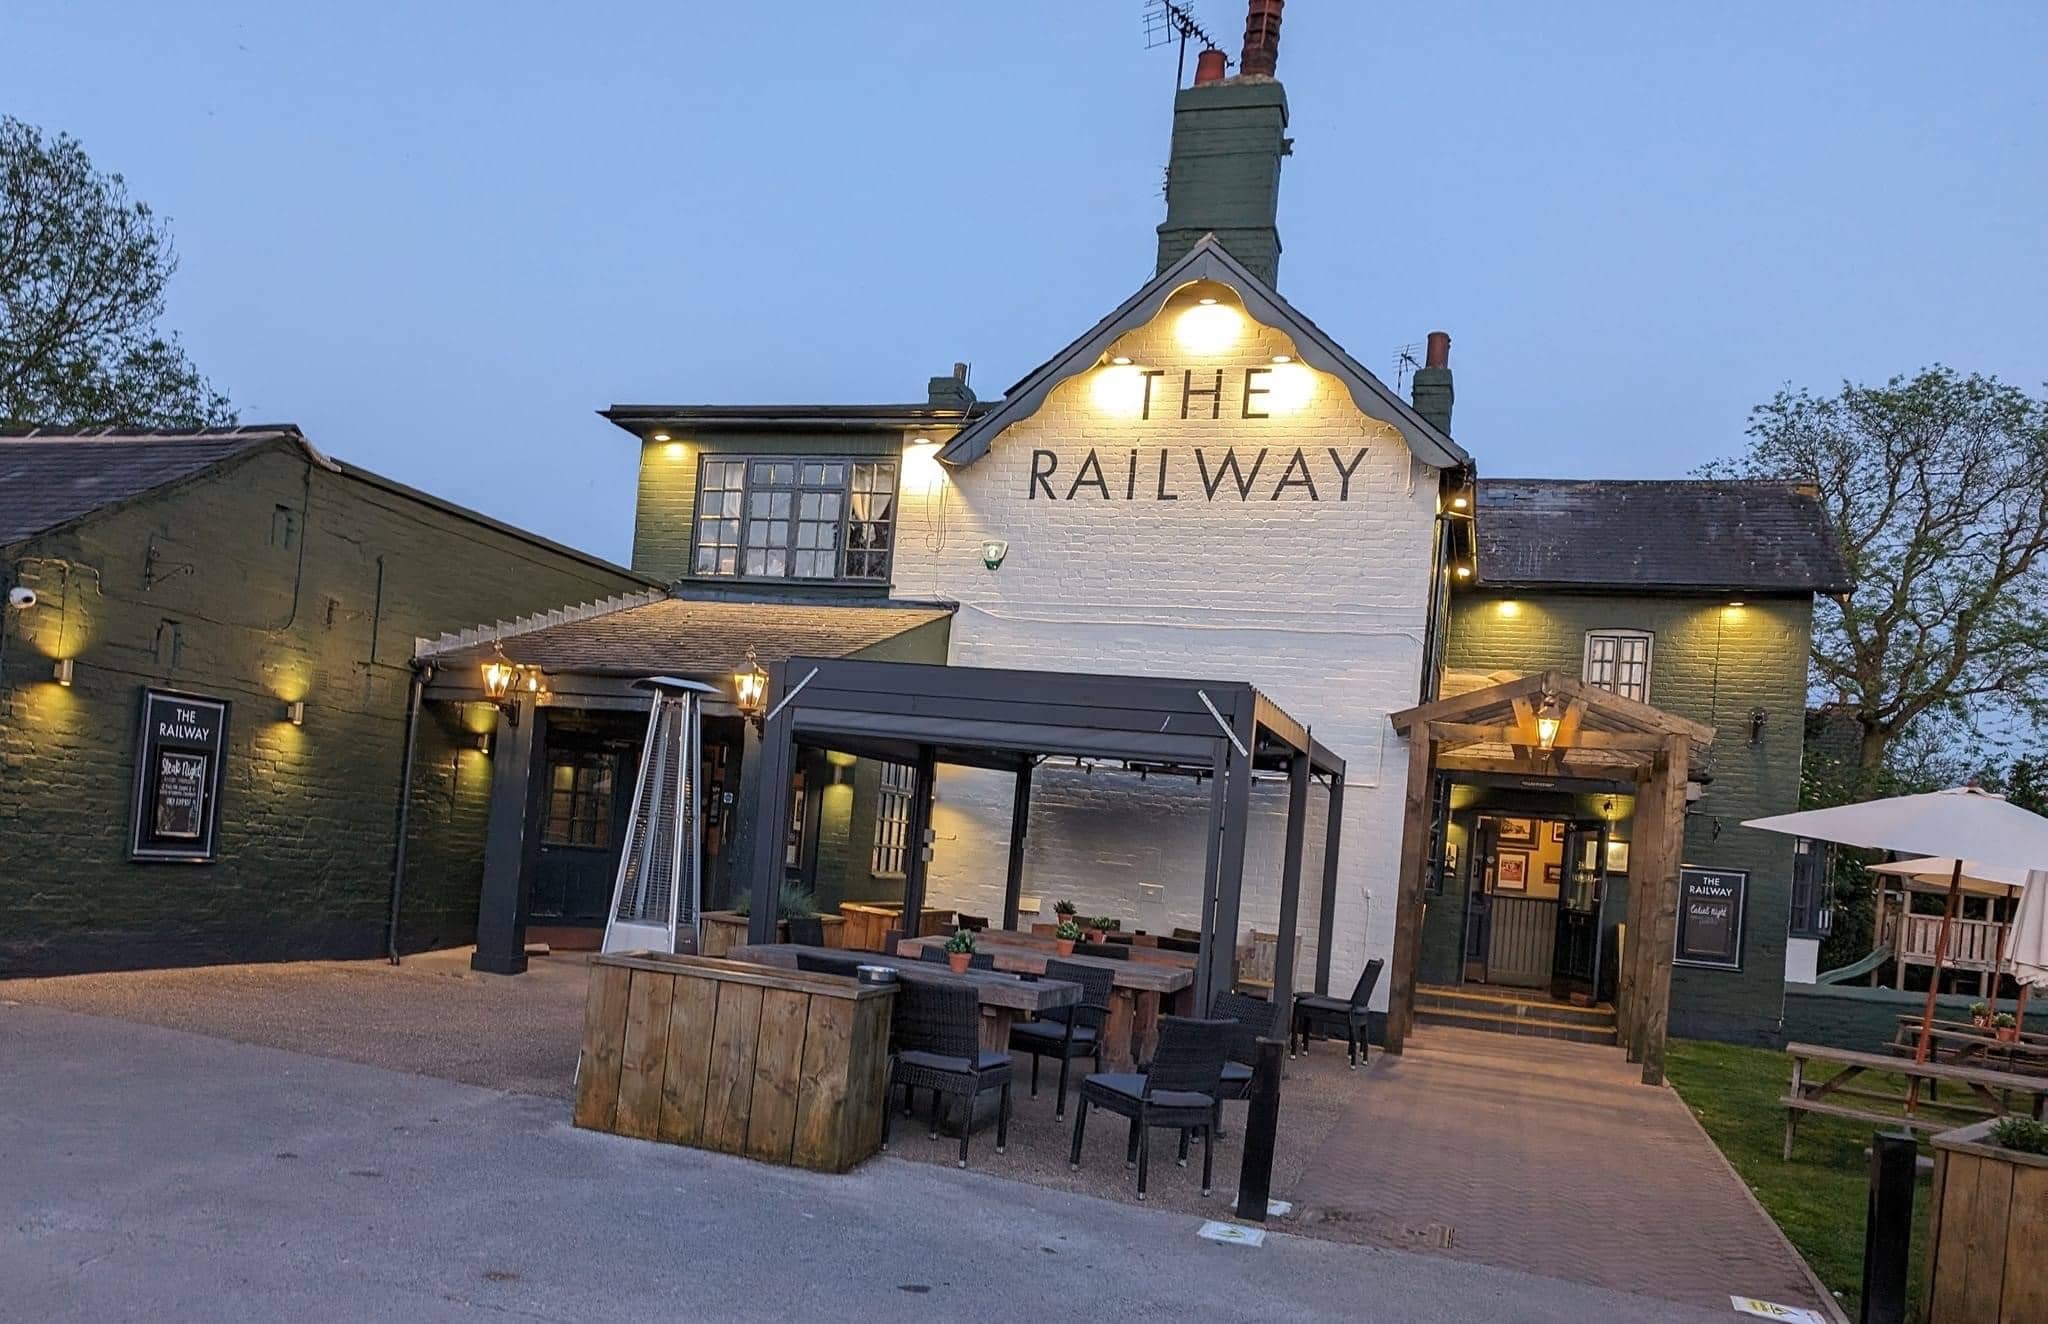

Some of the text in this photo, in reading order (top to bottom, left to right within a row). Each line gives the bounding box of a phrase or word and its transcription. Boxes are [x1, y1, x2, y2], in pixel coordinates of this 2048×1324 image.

[1139, 368, 1273, 420] THE
[1028, 446, 1370, 502] RAILWAY
[177, 708, 196, 723] THE
[160, 722, 209, 741] RAILWAY
[1703, 876, 1721, 886] THE
[1689, 885, 1733, 896] RAILWAY
